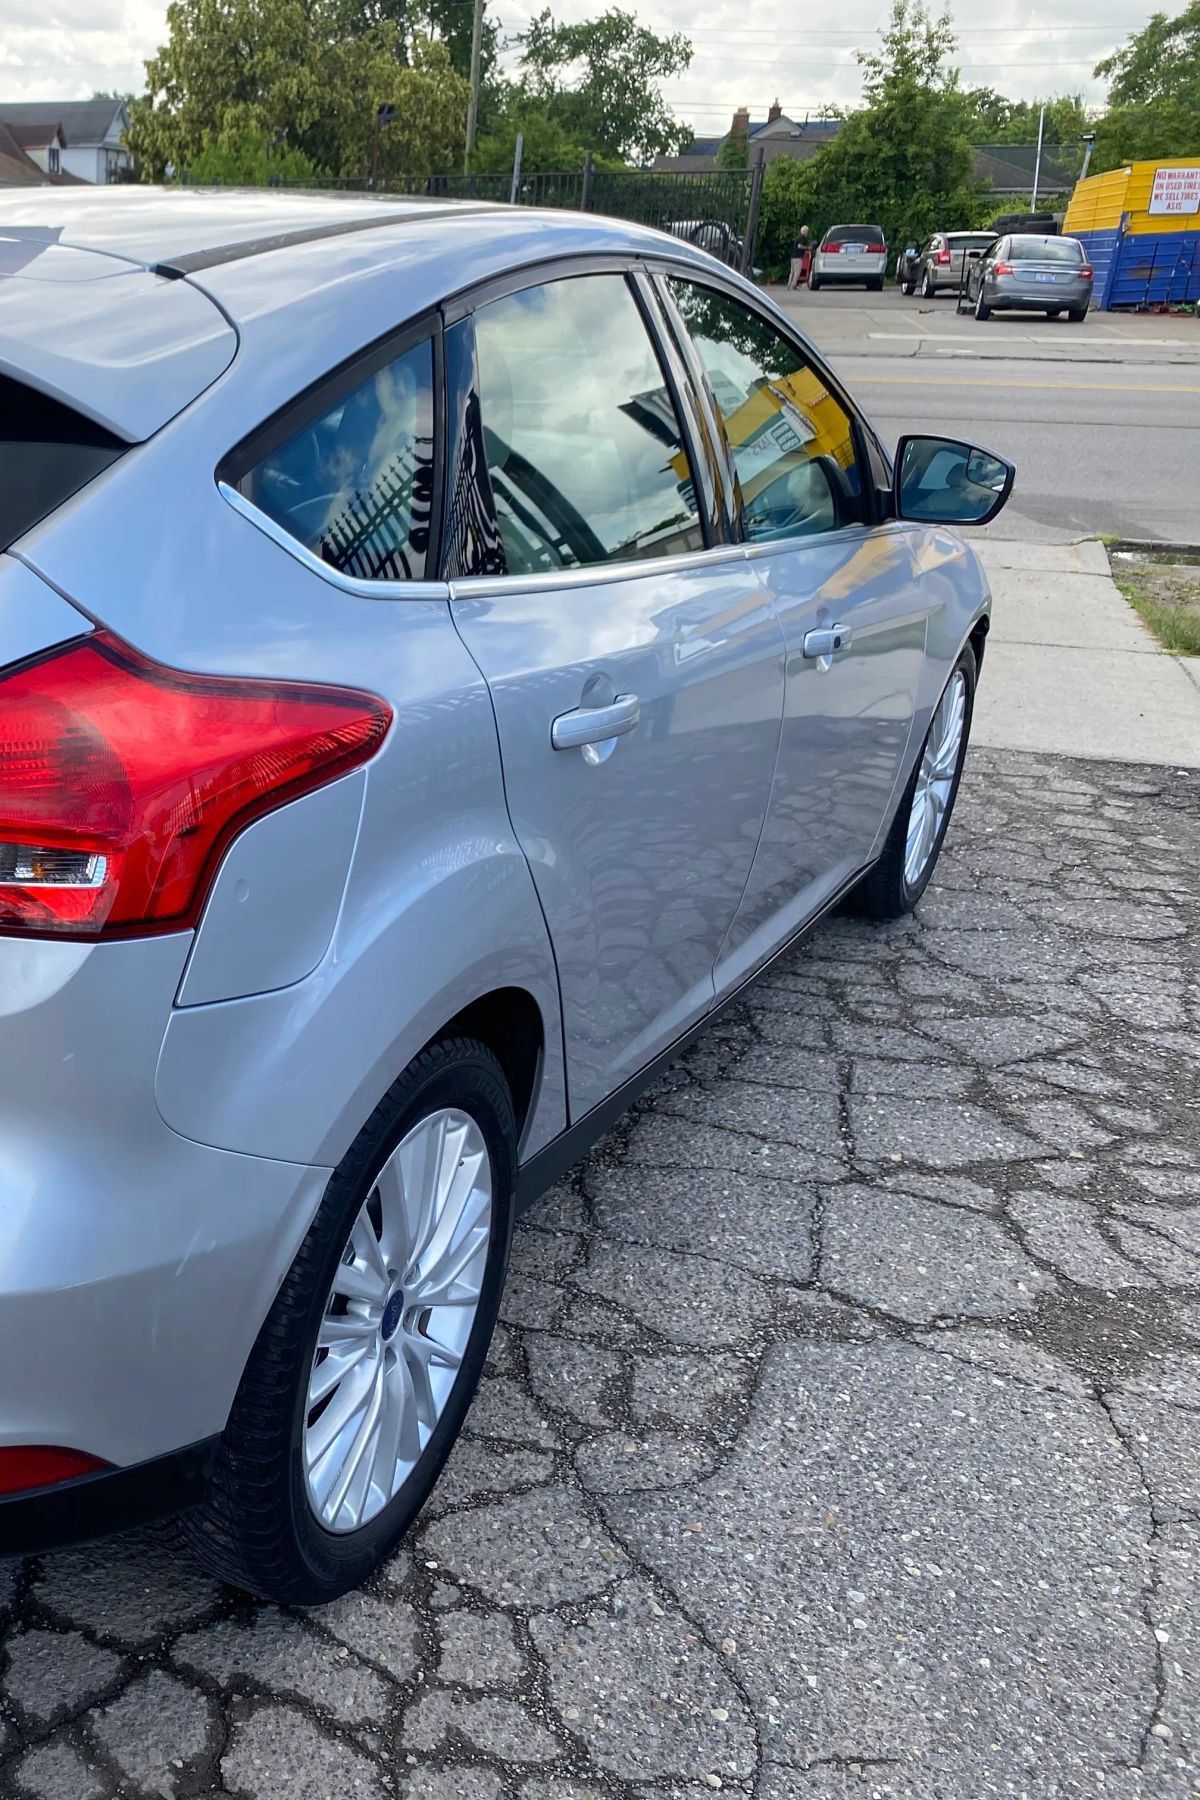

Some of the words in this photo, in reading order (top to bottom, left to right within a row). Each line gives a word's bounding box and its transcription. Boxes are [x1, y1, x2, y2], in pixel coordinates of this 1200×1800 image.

[1156, 171, 1167, 180] NO
[1166, 181, 1183, 190] USED
[1154, 192, 1164, 201] WE
[1165, 192, 1180, 201] SELL
